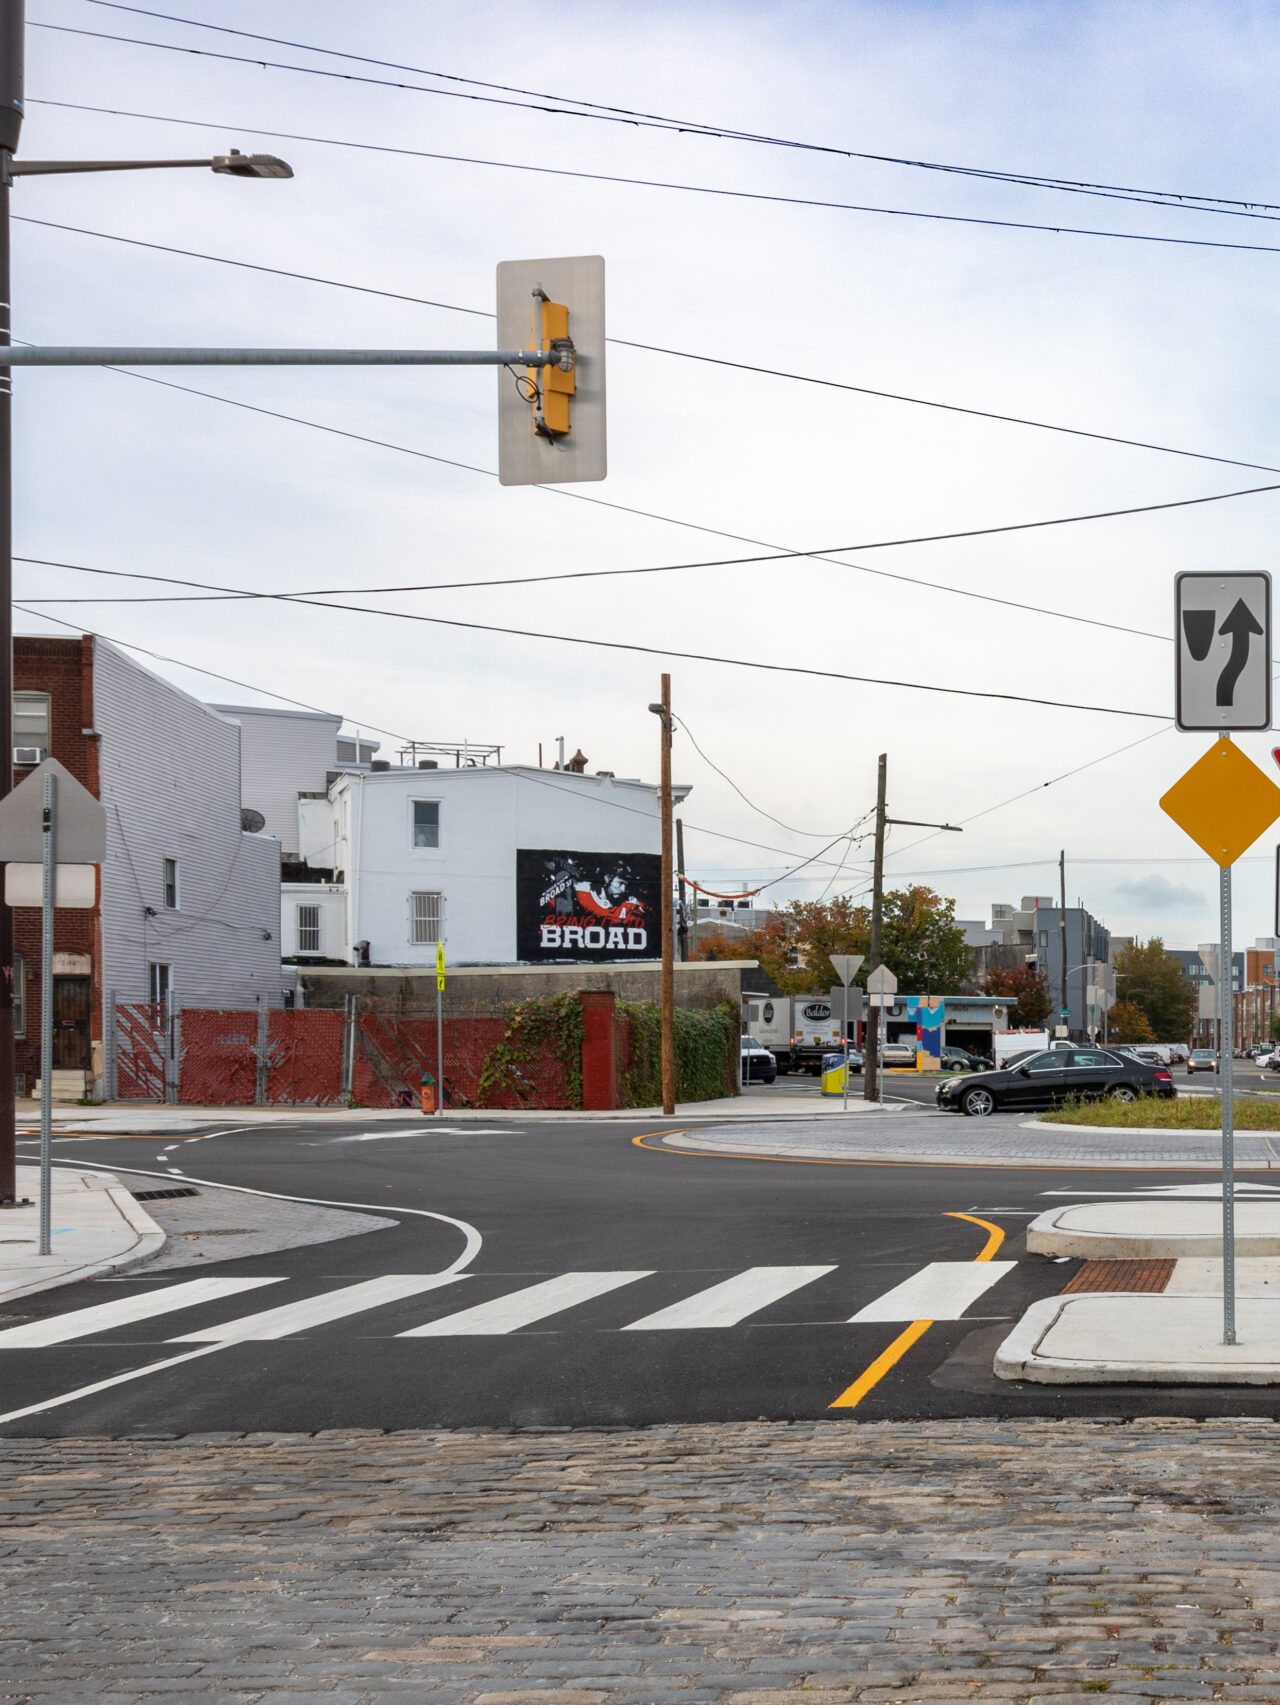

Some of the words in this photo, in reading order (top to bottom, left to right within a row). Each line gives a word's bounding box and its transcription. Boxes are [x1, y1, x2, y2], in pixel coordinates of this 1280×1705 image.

[539, 882, 565, 907] BROAD
[543, 915, 595, 929] BRING
[540, 924, 647, 950] BROAD
[805, 1004, 831, 1017] Baldor
